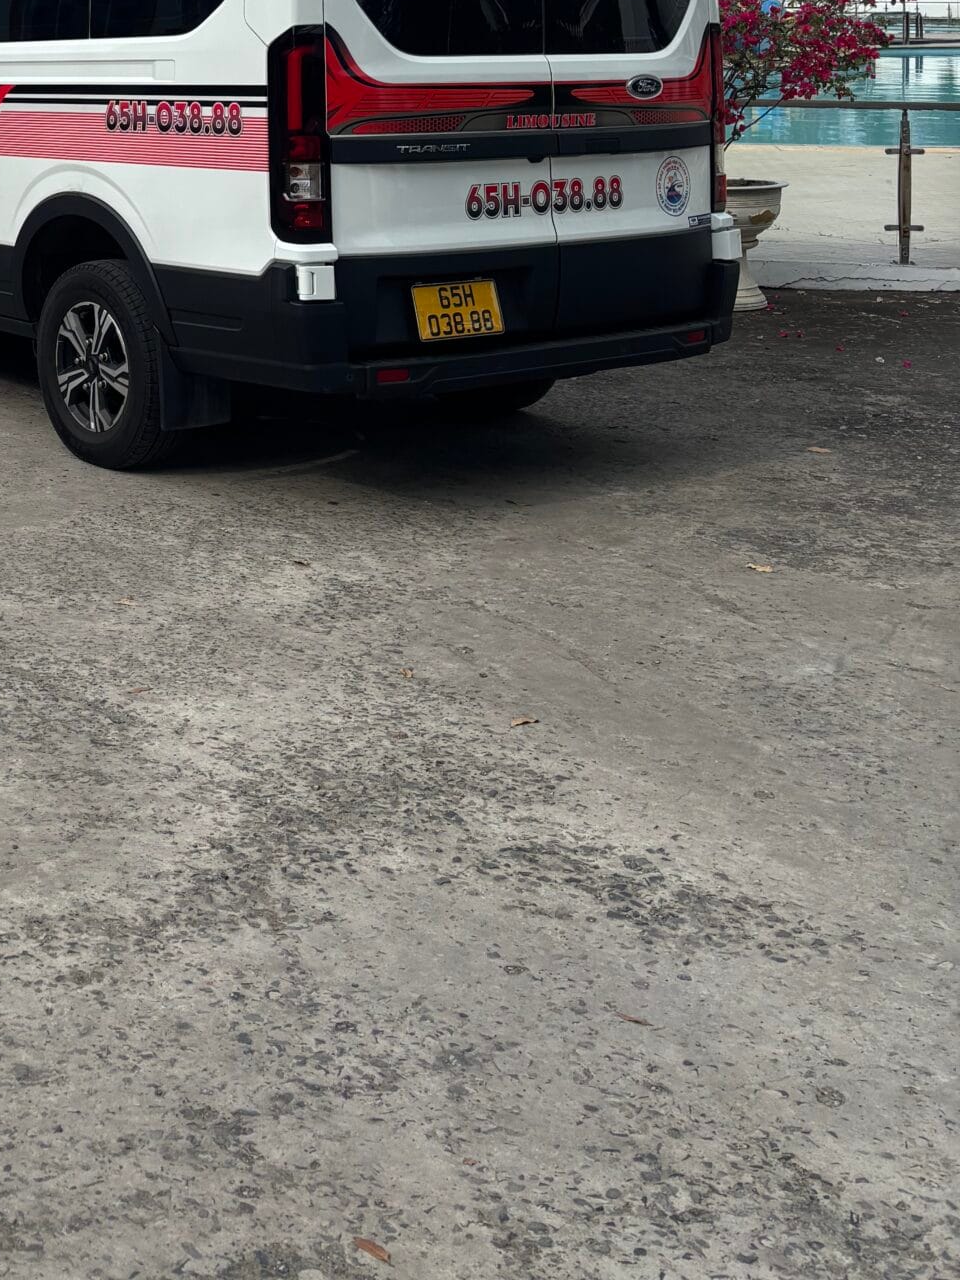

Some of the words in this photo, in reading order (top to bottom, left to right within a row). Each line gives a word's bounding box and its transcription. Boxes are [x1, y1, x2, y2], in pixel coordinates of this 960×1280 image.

[105, 100, 243, 137] 65H-038.88
[506, 112, 596, 129] LIMOUSINE
[396, 143, 471, 154] TRANSIT
[464, 174, 624, 221] 65H-038.88
[438, 284, 476, 309] 65H
[427, 309, 494, 337] 038.88
